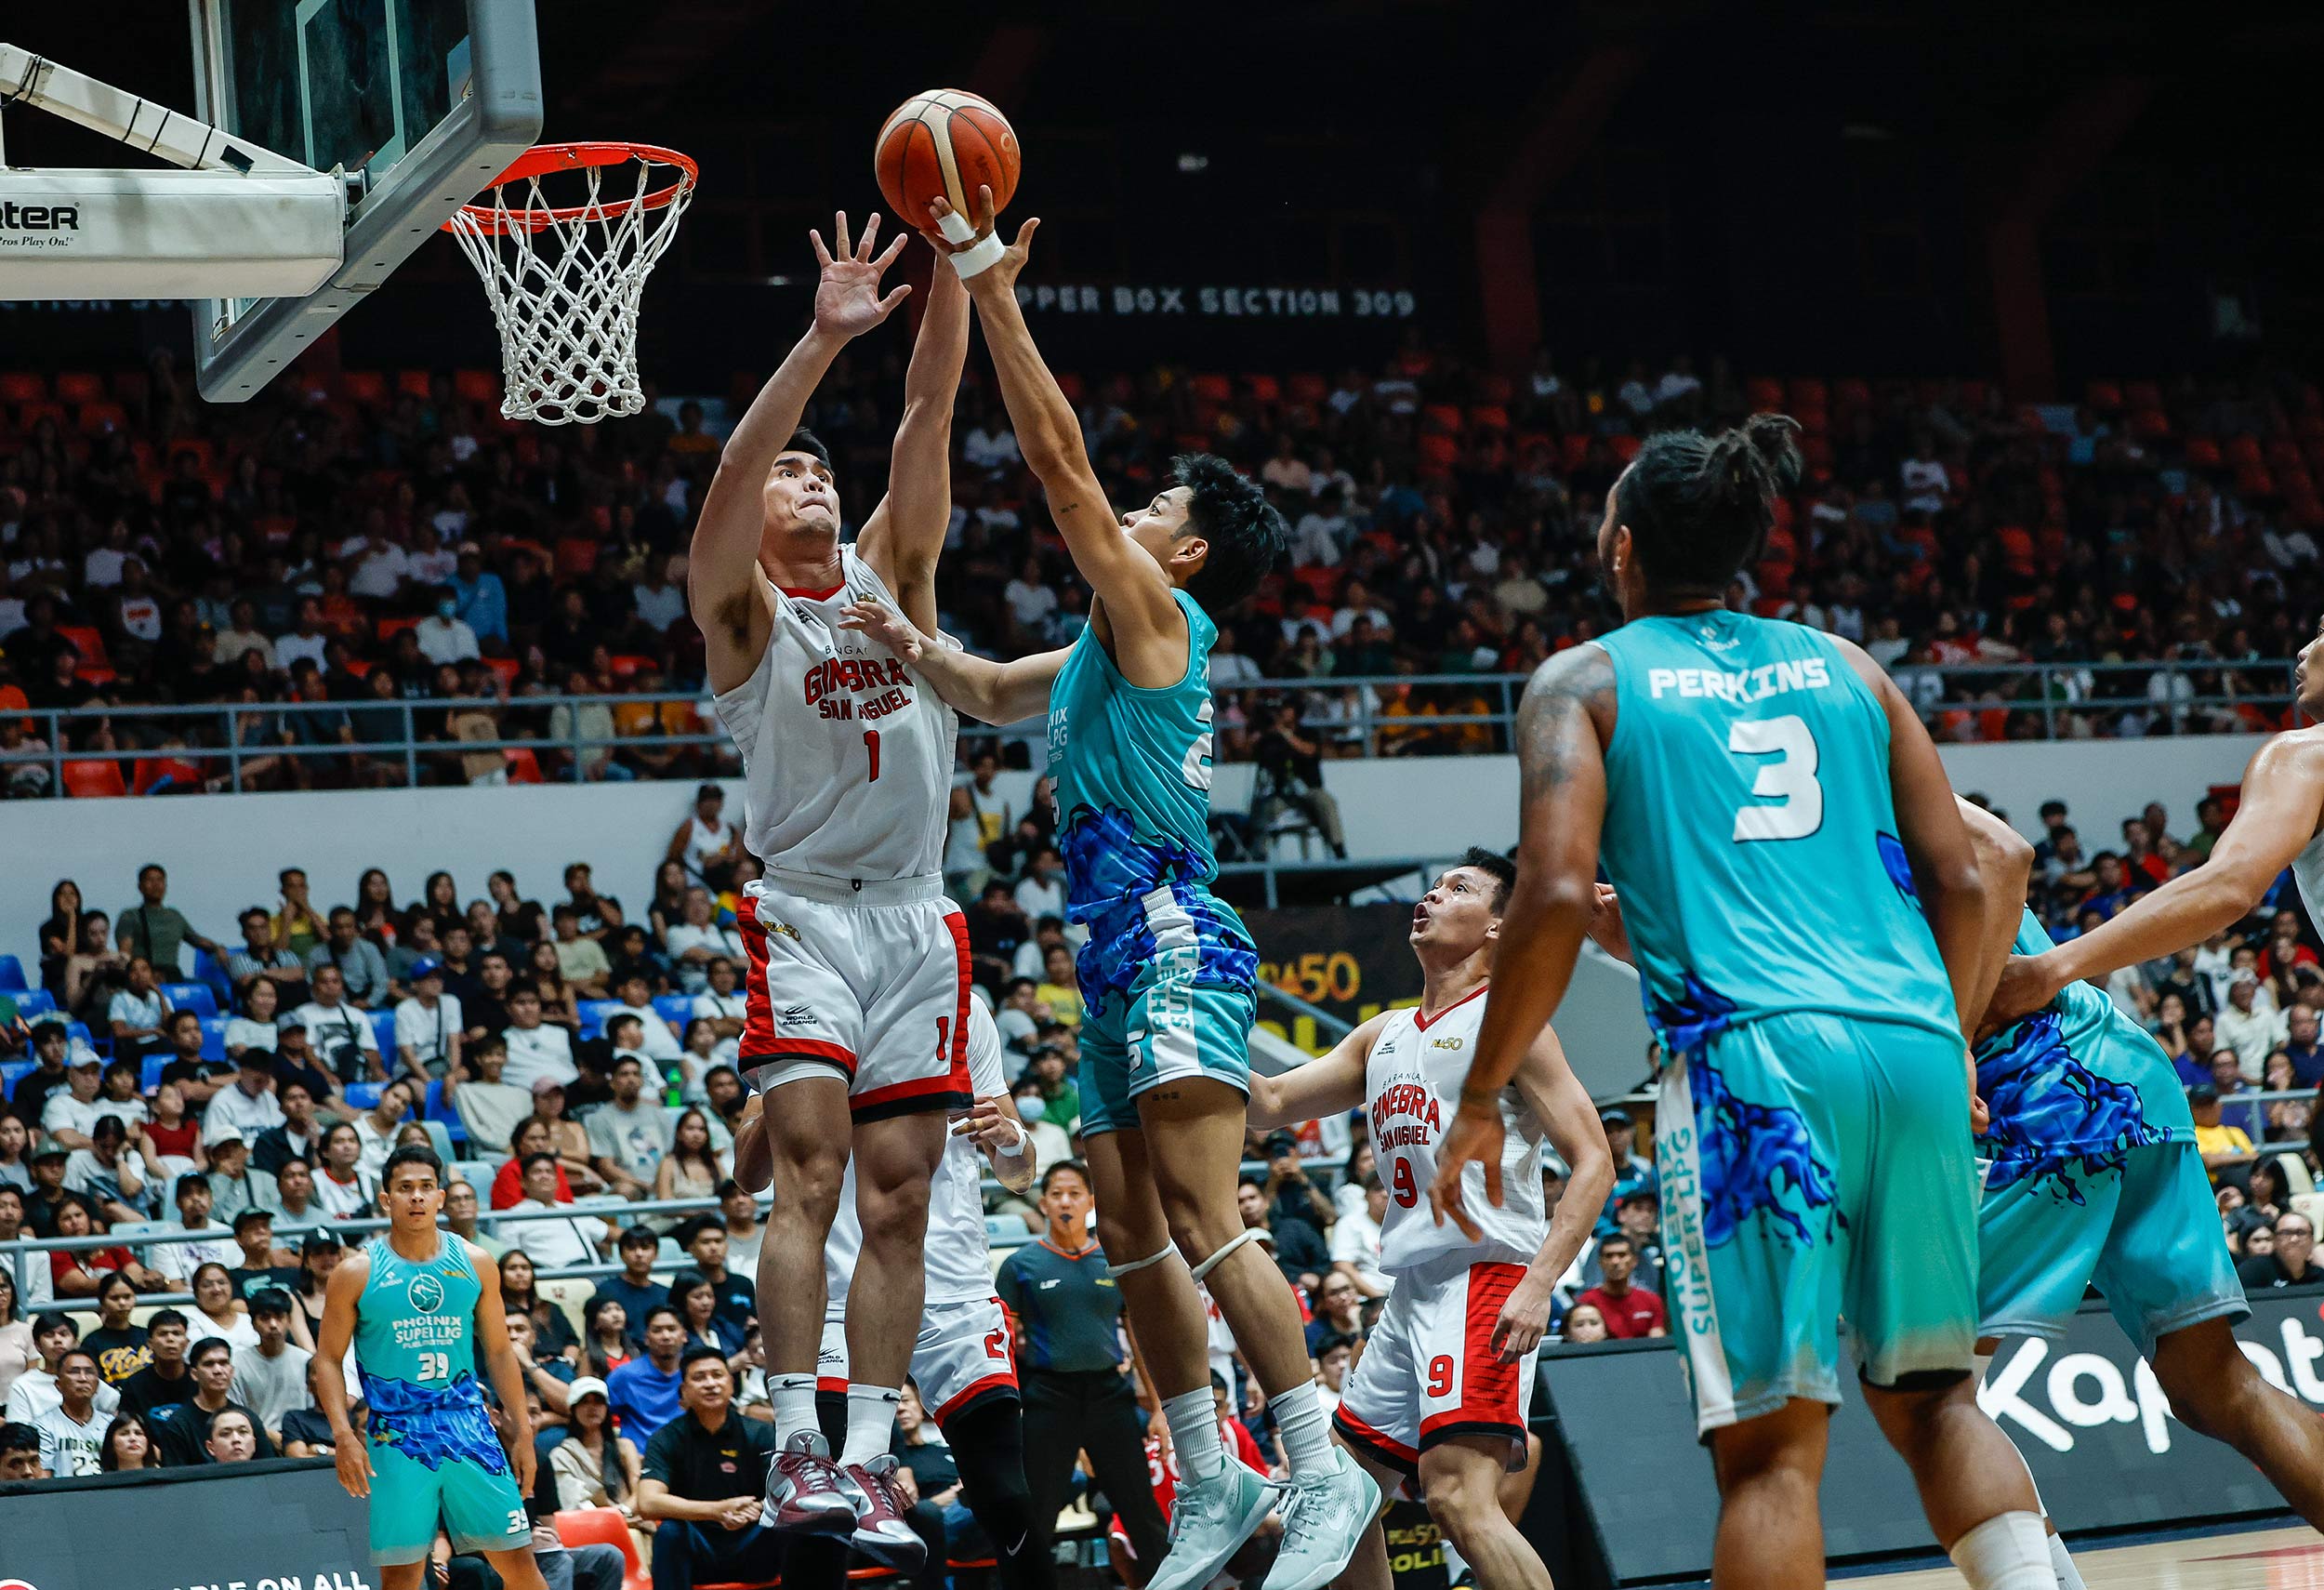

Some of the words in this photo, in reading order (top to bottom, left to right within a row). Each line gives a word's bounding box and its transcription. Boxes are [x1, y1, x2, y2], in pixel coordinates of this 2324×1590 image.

[21, 236, 46, 248] Play
[49, 236, 70, 246] On!
[1115, 285, 1185, 314] BOX
[1199, 287, 1340, 316] SECTION
[1353, 290, 1415, 317] 309
[1648, 656, 1830, 704] PERKINS
[818, 698, 852, 721] SAN
[863, 729, 881, 783] 1
[1728, 714, 1823, 845] 3
[936, 1015, 949, 1061] 1
[1372, 1083, 1441, 1141] GINEBRA
[1393, 1156, 1419, 1209] 9
[1670, 1127, 1697, 1199] LPG
[1683, 1211, 1716, 1336] SUPER
[391, 1315, 463, 1331] PHOENIX
[984, 1328, 1006, 1359] 2
[1427, 1354, 1454, 1398] 9
